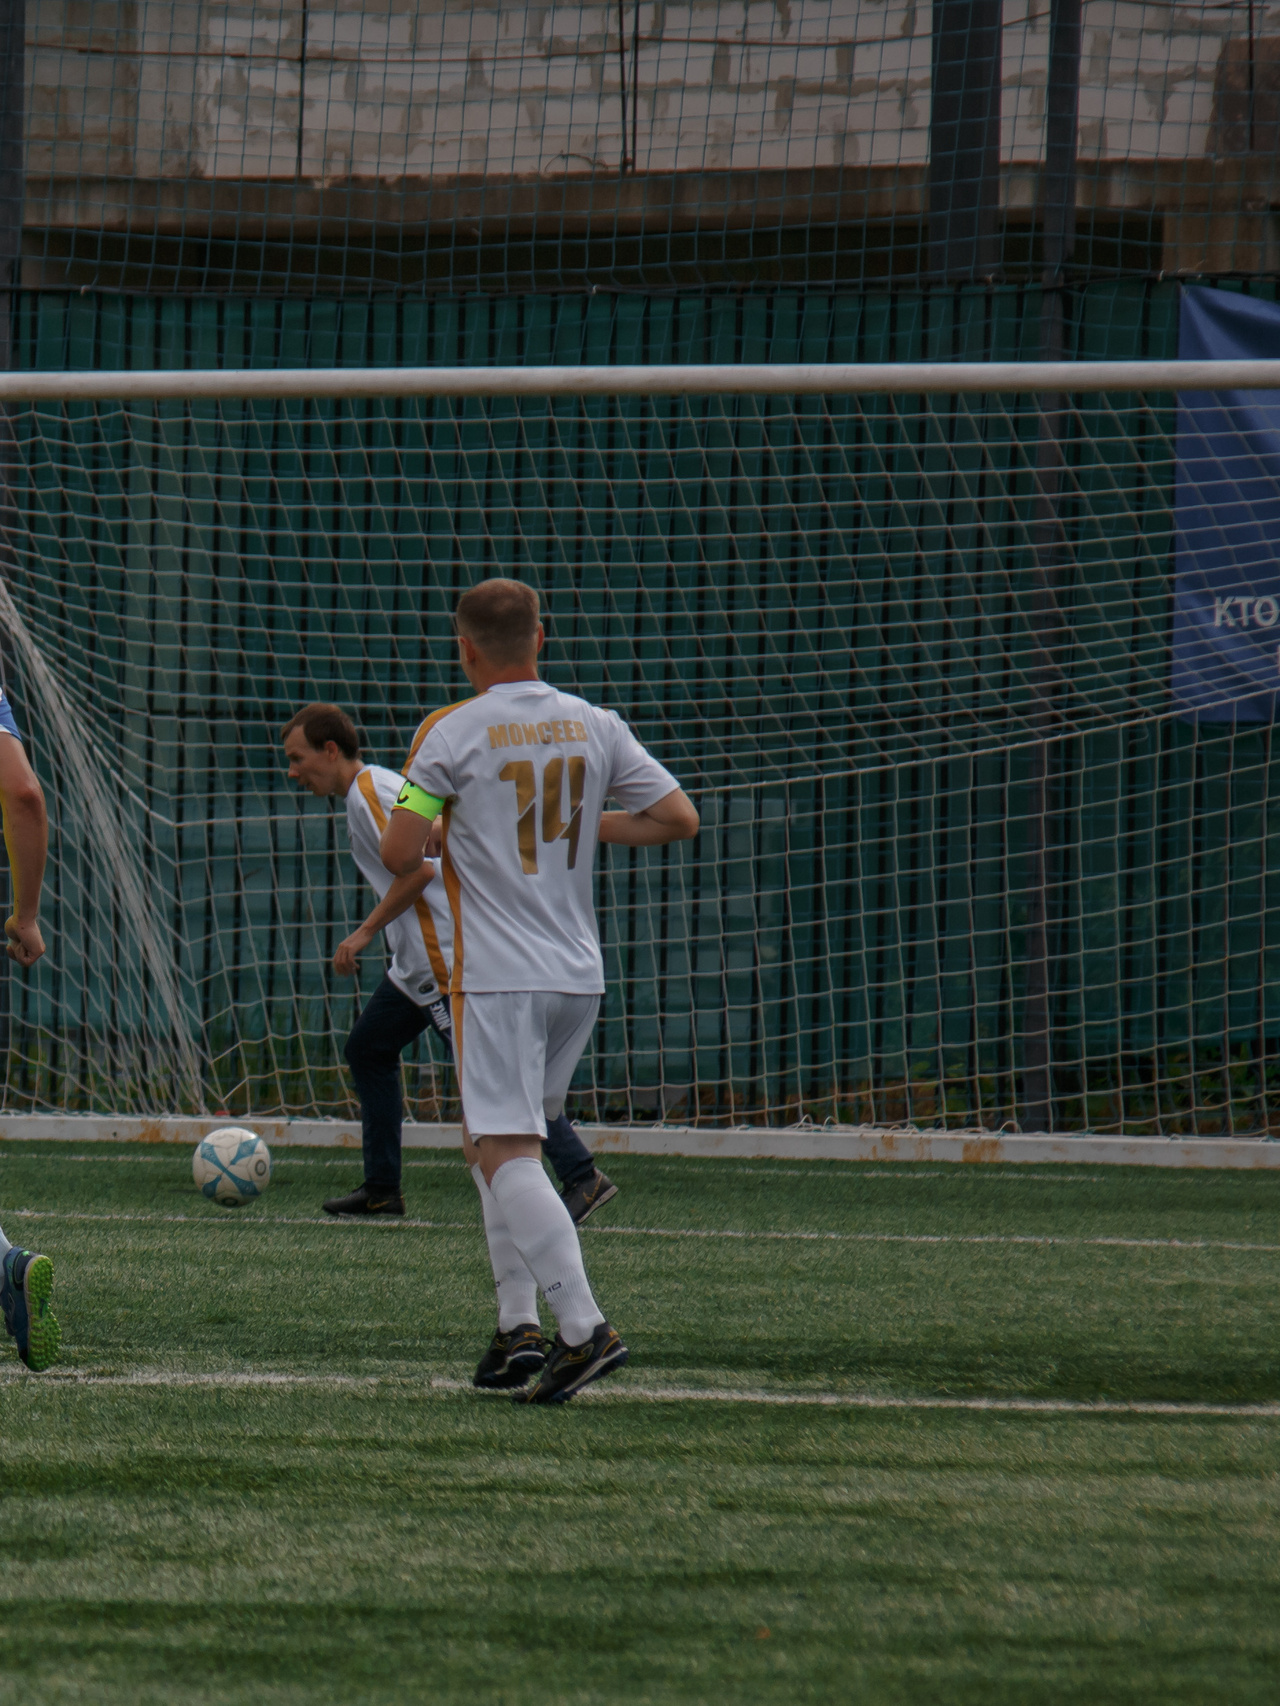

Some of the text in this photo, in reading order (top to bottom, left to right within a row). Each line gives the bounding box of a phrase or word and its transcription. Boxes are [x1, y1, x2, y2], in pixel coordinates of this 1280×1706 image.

[1214, 595, 1280, 627] КТО
[499, 756, 586, 874] 14
[429, 1000, 451, 1031] NIKE
